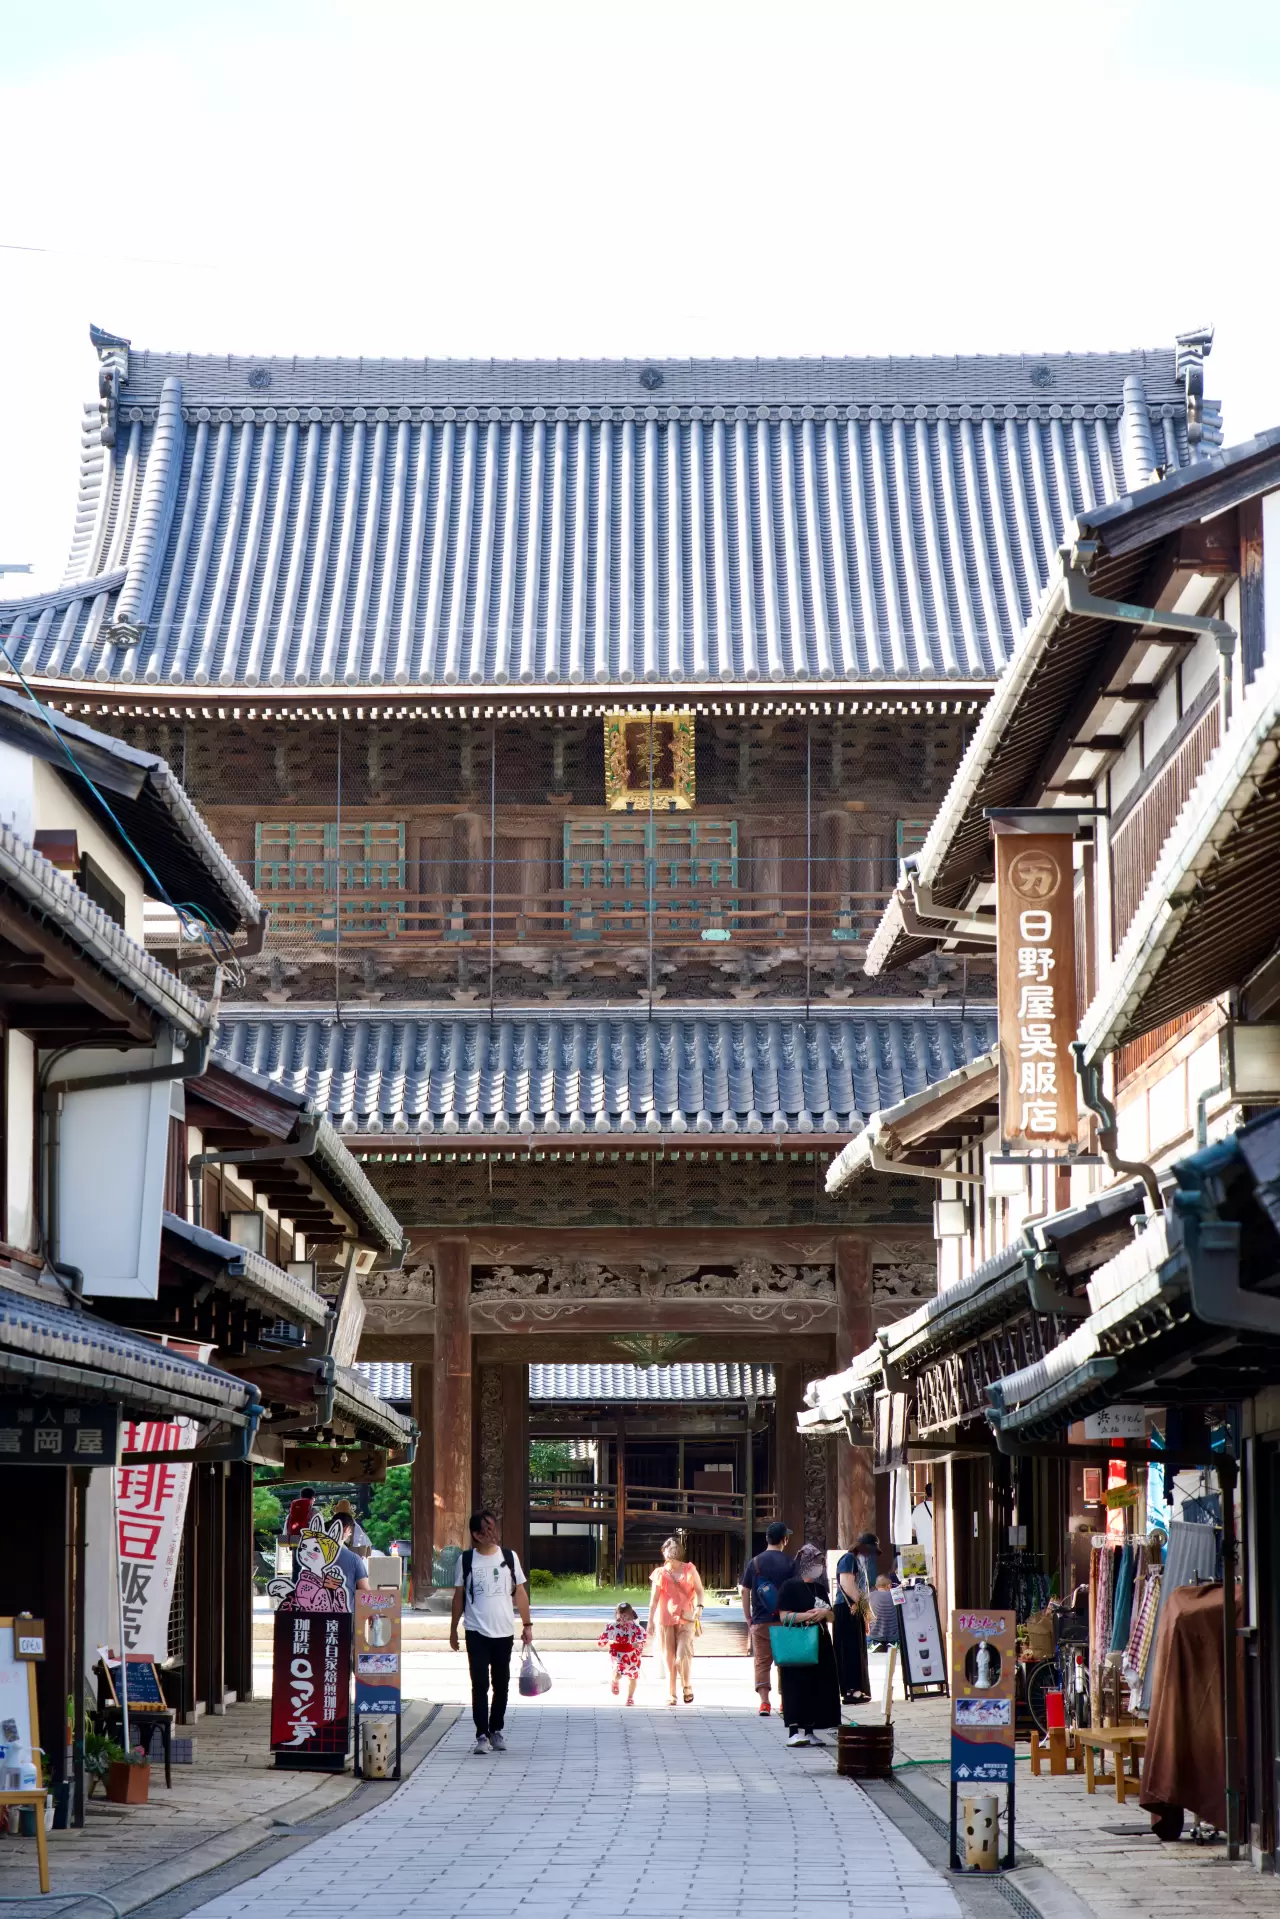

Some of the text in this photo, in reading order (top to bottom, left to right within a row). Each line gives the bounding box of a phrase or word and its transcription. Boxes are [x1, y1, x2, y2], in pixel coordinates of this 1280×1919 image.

[0, 1427, 104, 1454] 富岡屋
[21, 1638, 41, 1652] OPEN
[292, 1618, 311, 1655] 珈琲院
[280, 1658, 318, 1746] ロマン亭
